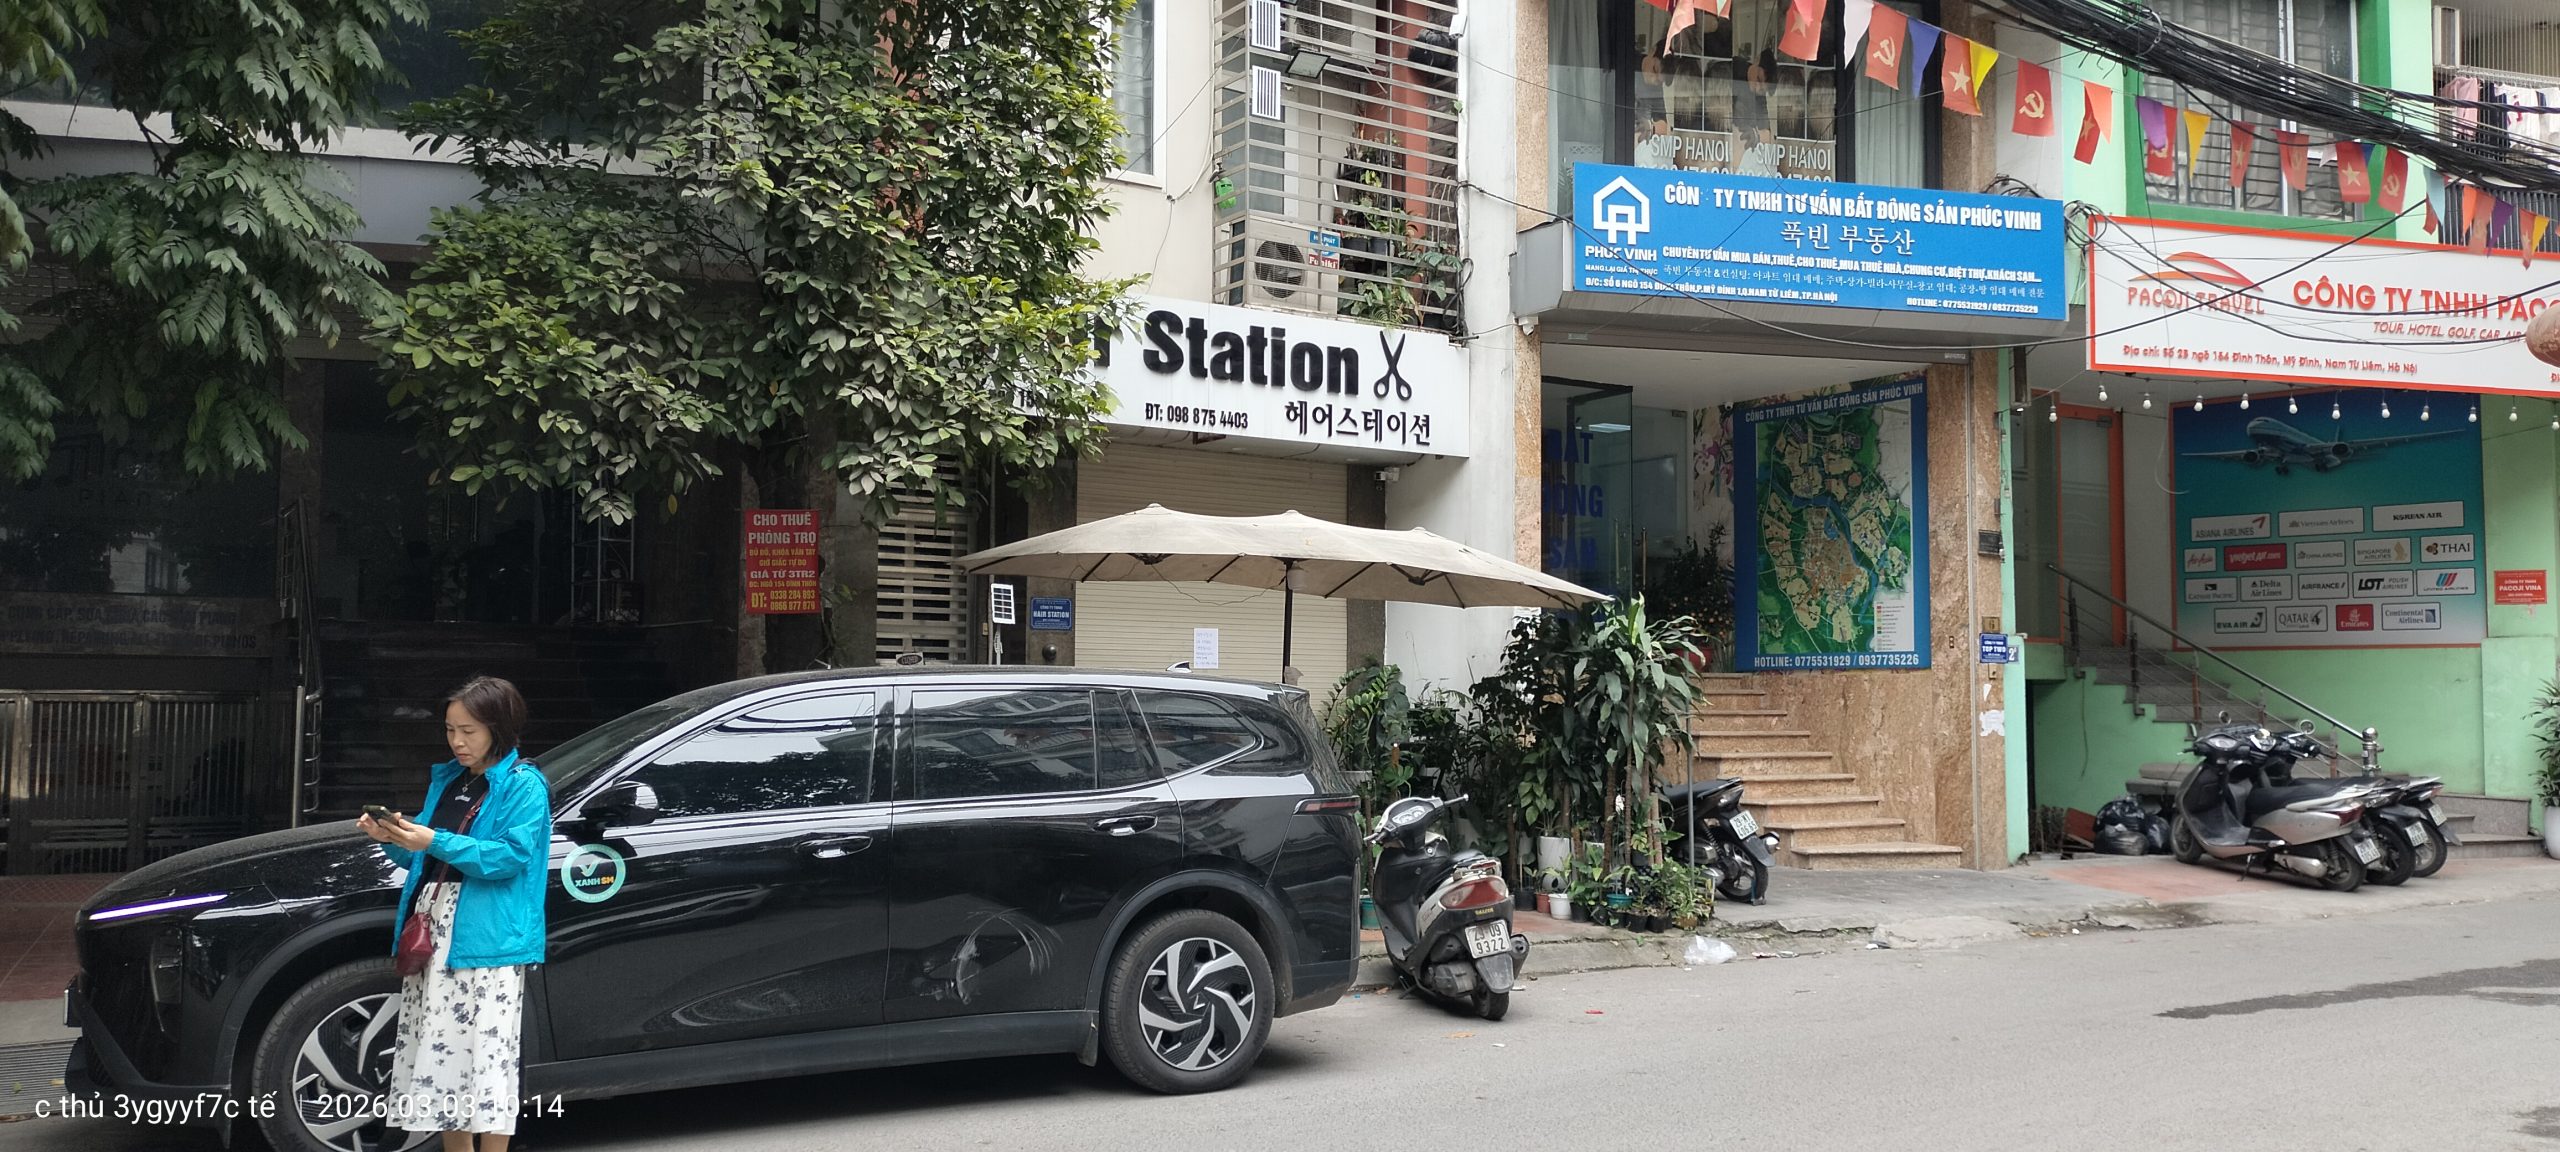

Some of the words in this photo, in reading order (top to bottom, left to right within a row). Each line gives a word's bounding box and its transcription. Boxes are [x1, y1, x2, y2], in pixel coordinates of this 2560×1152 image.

[1651, 134, 1682, 158] SMP
[1685, 137, 1730, 162] HANOI
[1755, 142, 1786, 166] SMP
[1789, 145, 1831, 171] HANOI
[1713, 188, 1736, 209] TY
[1738, 190, 1783, 213] TNHH
[1785, 192, 1810, 215] TƯ
[1811, 189, 1842, 217] VẤN
[1845, 192, 1873, 219] BẤT
[1876, 198, 1921, 224] ĐỘNG
[1923, 199, 1958, 225] SẢN
[1960, 204, 2003, 228] PHÚC
[2005, 210, 2042, 231] VINH
[1838, 225, 1915, 255] 부동산
[1624, 247, 1657, 262] VINH
[1731, 253, 1750, 264] MUA
[1860, 260, 1883, 273] THUÊ
[1640, 281, 1653, 290] 154
[2293, 275, 2377, 311] CÔNG
[2384, 287, 2413, 313] TY
[2420, 289, 2489, 318] TNHH
[1143, 309, 1360, 396] Station
[2123, 344, 2140, 358] Địa
[2232, 352, 2253, 363] Đình
[2325, 358, 2347, 370] Nam
[2387, 361, 2401, 373] Hà
[2403, 363, 2418, 375] Nội
[1745, 409, 1765, 423] CÔNG
[1766, 409, 1774, 419] TY
[1775, 407, 1795, 419] TNHH
[1795, 404, 1806, 414] TƯ
[1807, 401, 1822, 413] VẤN
[1823, 397, 1838, 410] BẤT
[1839, 395, 1861, 409] ĐỘNG
[1862, 391, 1878, 404] SẢN
[1879, 386, 1901, 400] PHÚC
[1903, 382, 1923, 396] VINH
[1145, 403, 1163, 422] ĐT:
[1167, 405, 1189, 424] 098
[1220, 408, 1249, 429] 4403
[1285, 400, 1431, 447] 헤어스테이션
[753, 513, 778, 526] CHO
[781, 511, 812, 526] THUÊ
[2426, 511, 2442, 519] AIR
[748, 529, 791, 544] PHÒNG
[793, 531, 817, 546] TRỌ
[2195, 528, 2222, 539] ASIANA
[2222, 526, 2255, 537] AIRLINES
[2440, 542, 2471, 554] THAI
[750, 569, 769, 578] GIÁ
[772, 568, 787, 578] TỪ
[788, 570, 815, 578] 3TR2
[2259, 579, 2281, 588] Delta
[2358, 578, 2385, 591] LOT
[2250, 589, 2262, 597] Air
[2262, 588, 2282, 597] Lines
[2278, 613, 2309, 625] QATAR
[2385, 608, 2424, 618] Continental
[2398, 616, 2425, 624] Airlines
[2340, 620, 2369, 628] Emirates
[1754, 656, 1793, 668] HOTLINE:
[1794, 655, 1851, 667] 0775531929
[1858, 654, 1919, 666] 0937735226
[574, 877, 601, 887] XANH
[600, 876, 614, 885] SM
[1476, 937, 1506, 955] 9322
